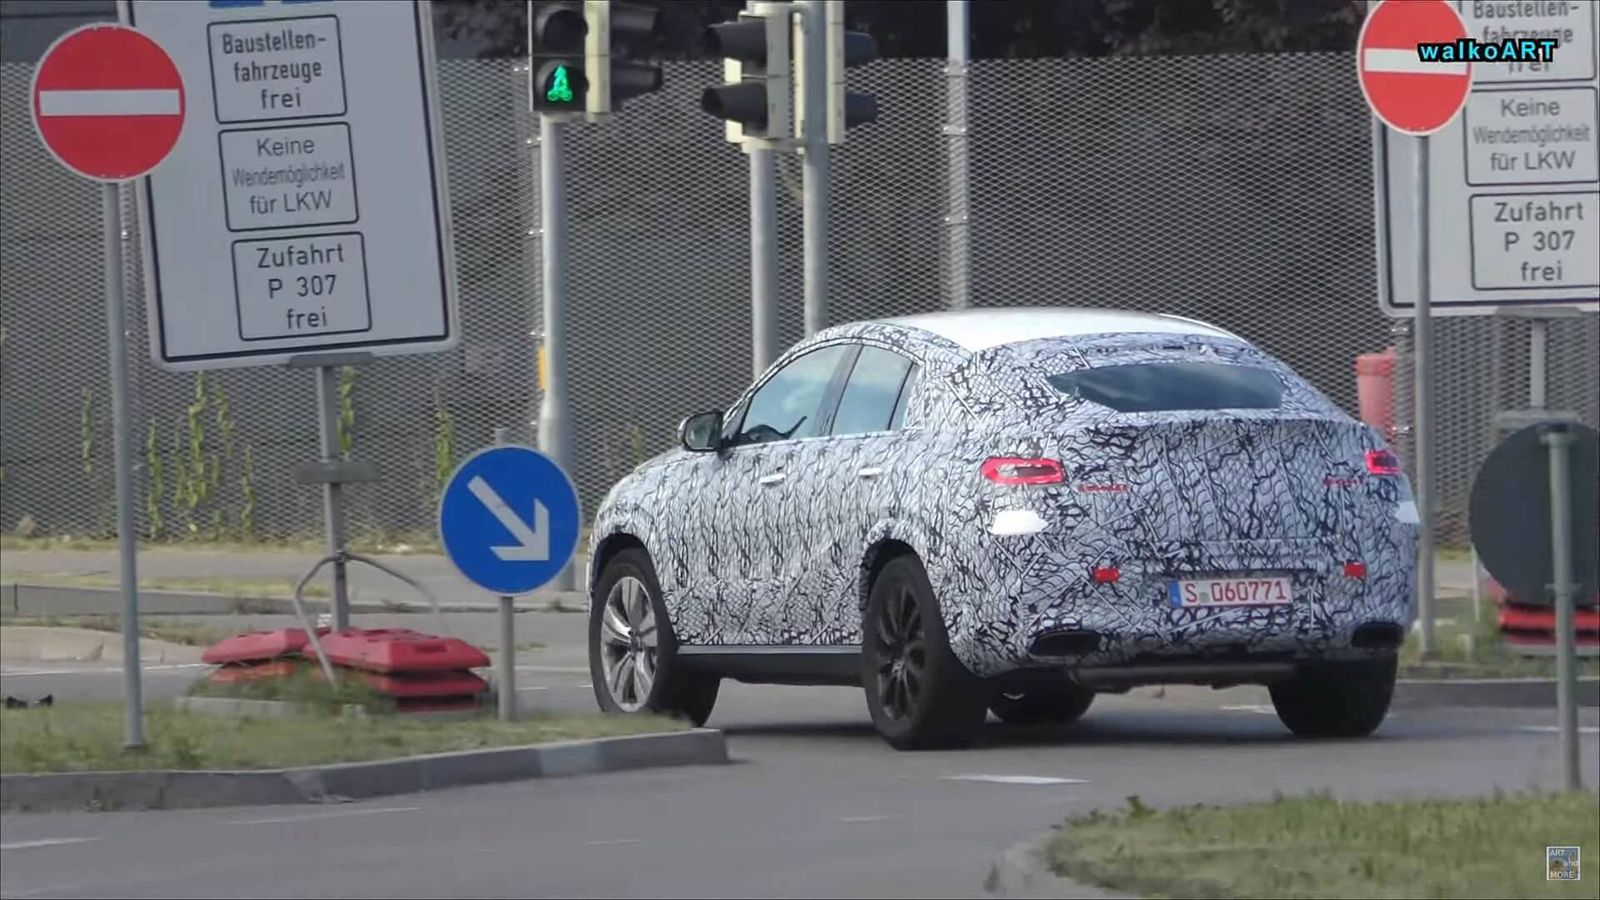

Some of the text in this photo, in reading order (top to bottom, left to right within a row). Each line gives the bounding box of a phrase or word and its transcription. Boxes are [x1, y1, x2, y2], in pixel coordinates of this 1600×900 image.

[1473, 0, 1579, 19] Baustellen-
[222, 29, 327, 54] Baustellen-
[233, 59, 322, 83] fahrzeuge
[260, 86, 302, 110] frei
[1501, 99, 1561, 118] Keine
[256, 137, 316, 157] Keine
[1490, 150, 1576, 171] für LKW
[249, 189, 333, 215] für LKW
[1494, 201, 1584, 223] Zufahrt
[1504, 230, 1575, 252] P 307
[256, 243, 345, 269] Zufahrt
[1520, 260, 1563, 281] frei
[268, 274, 337, 299] P 307
[286, 306, 328, 330] frei
[1184, 580, 1287, 603] S 060771
